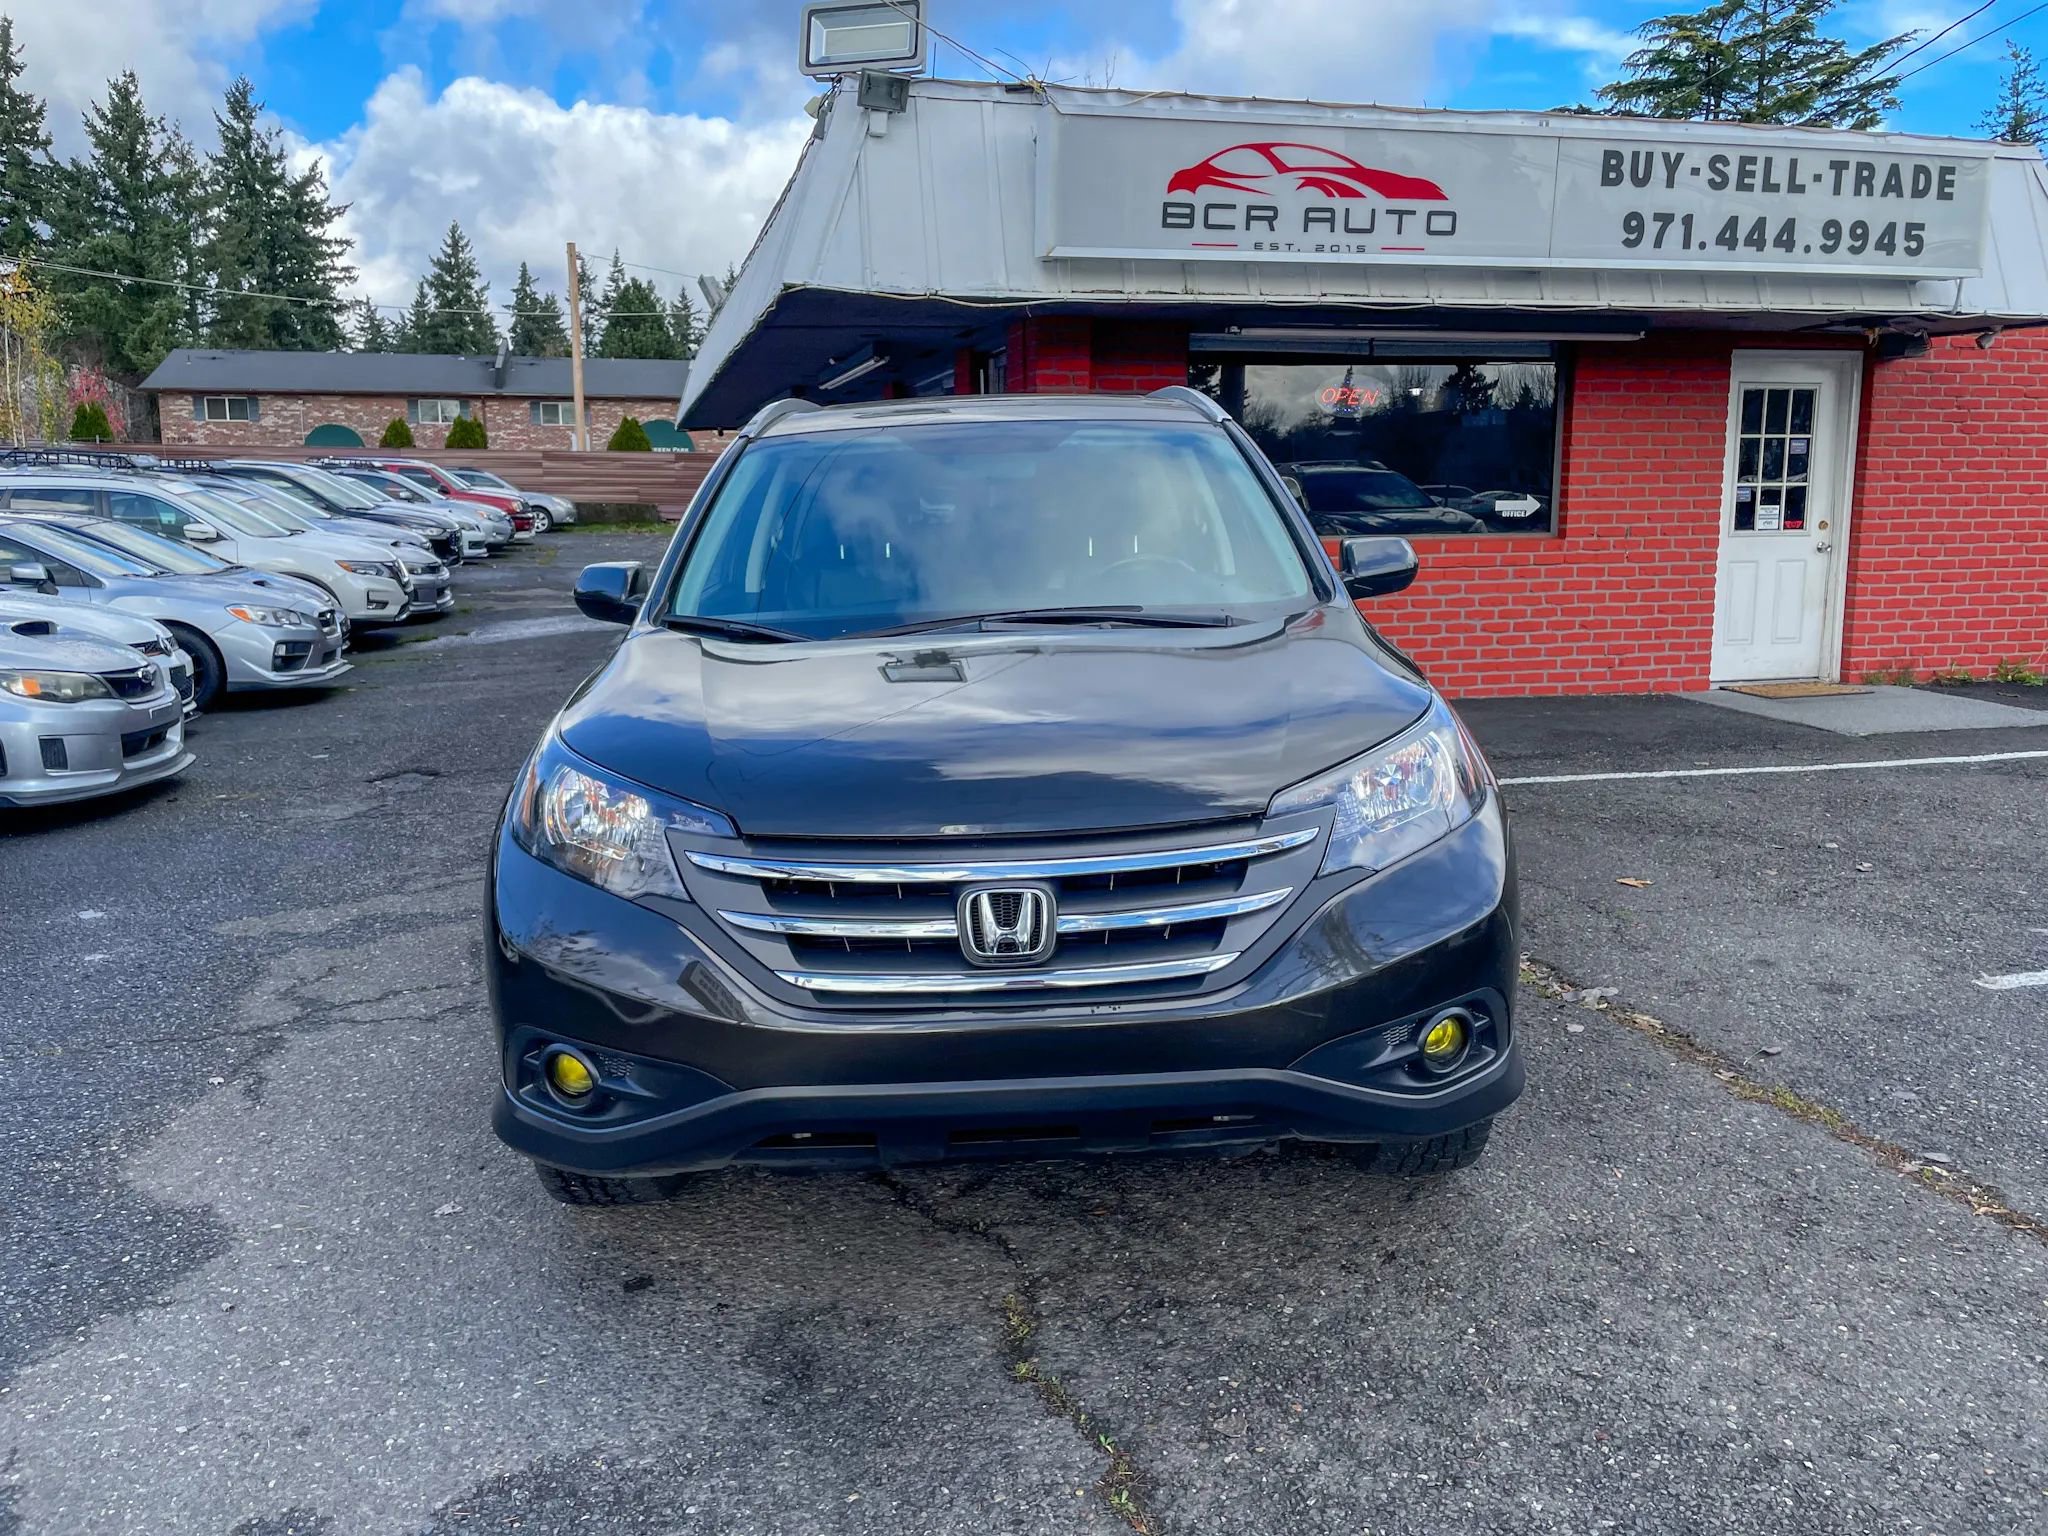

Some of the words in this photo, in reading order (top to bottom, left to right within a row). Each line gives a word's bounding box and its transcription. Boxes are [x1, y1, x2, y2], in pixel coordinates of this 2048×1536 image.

[1162, 202, 1278, 231] BCR
[1303, 207, 1457, 236] AUTO
[1253, 241, 1301, 252] EST.
[1315, 244, 1367, 253] 2015
[1621, 211, 1926, 257] 971.444.9945
[1321, 387, 1380, 405] OPEN
